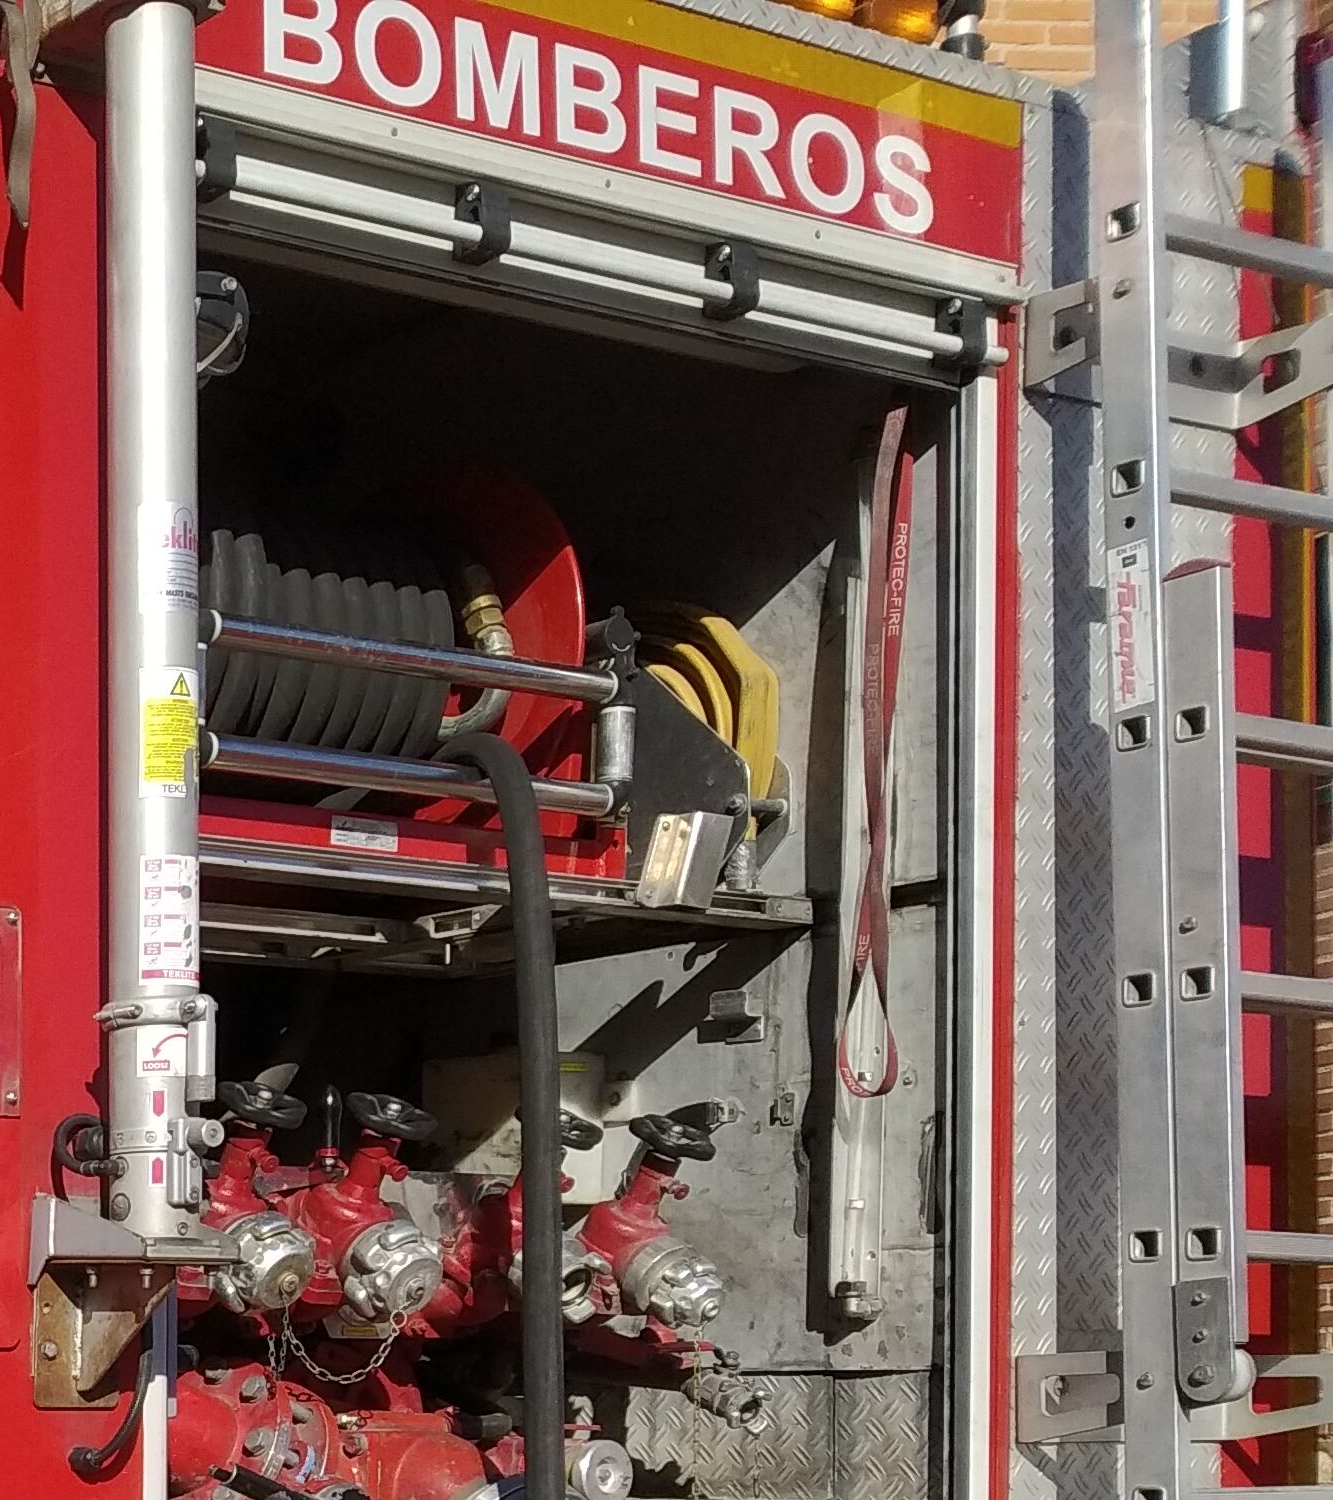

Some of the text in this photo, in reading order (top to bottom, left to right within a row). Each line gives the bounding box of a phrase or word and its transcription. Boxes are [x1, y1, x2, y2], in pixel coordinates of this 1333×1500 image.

[263, 0, 935, 236] BOMBEROS
[888, 521, 909, 638] PROTEC-FIRE
[162, 784, 186, 794] TEKL
